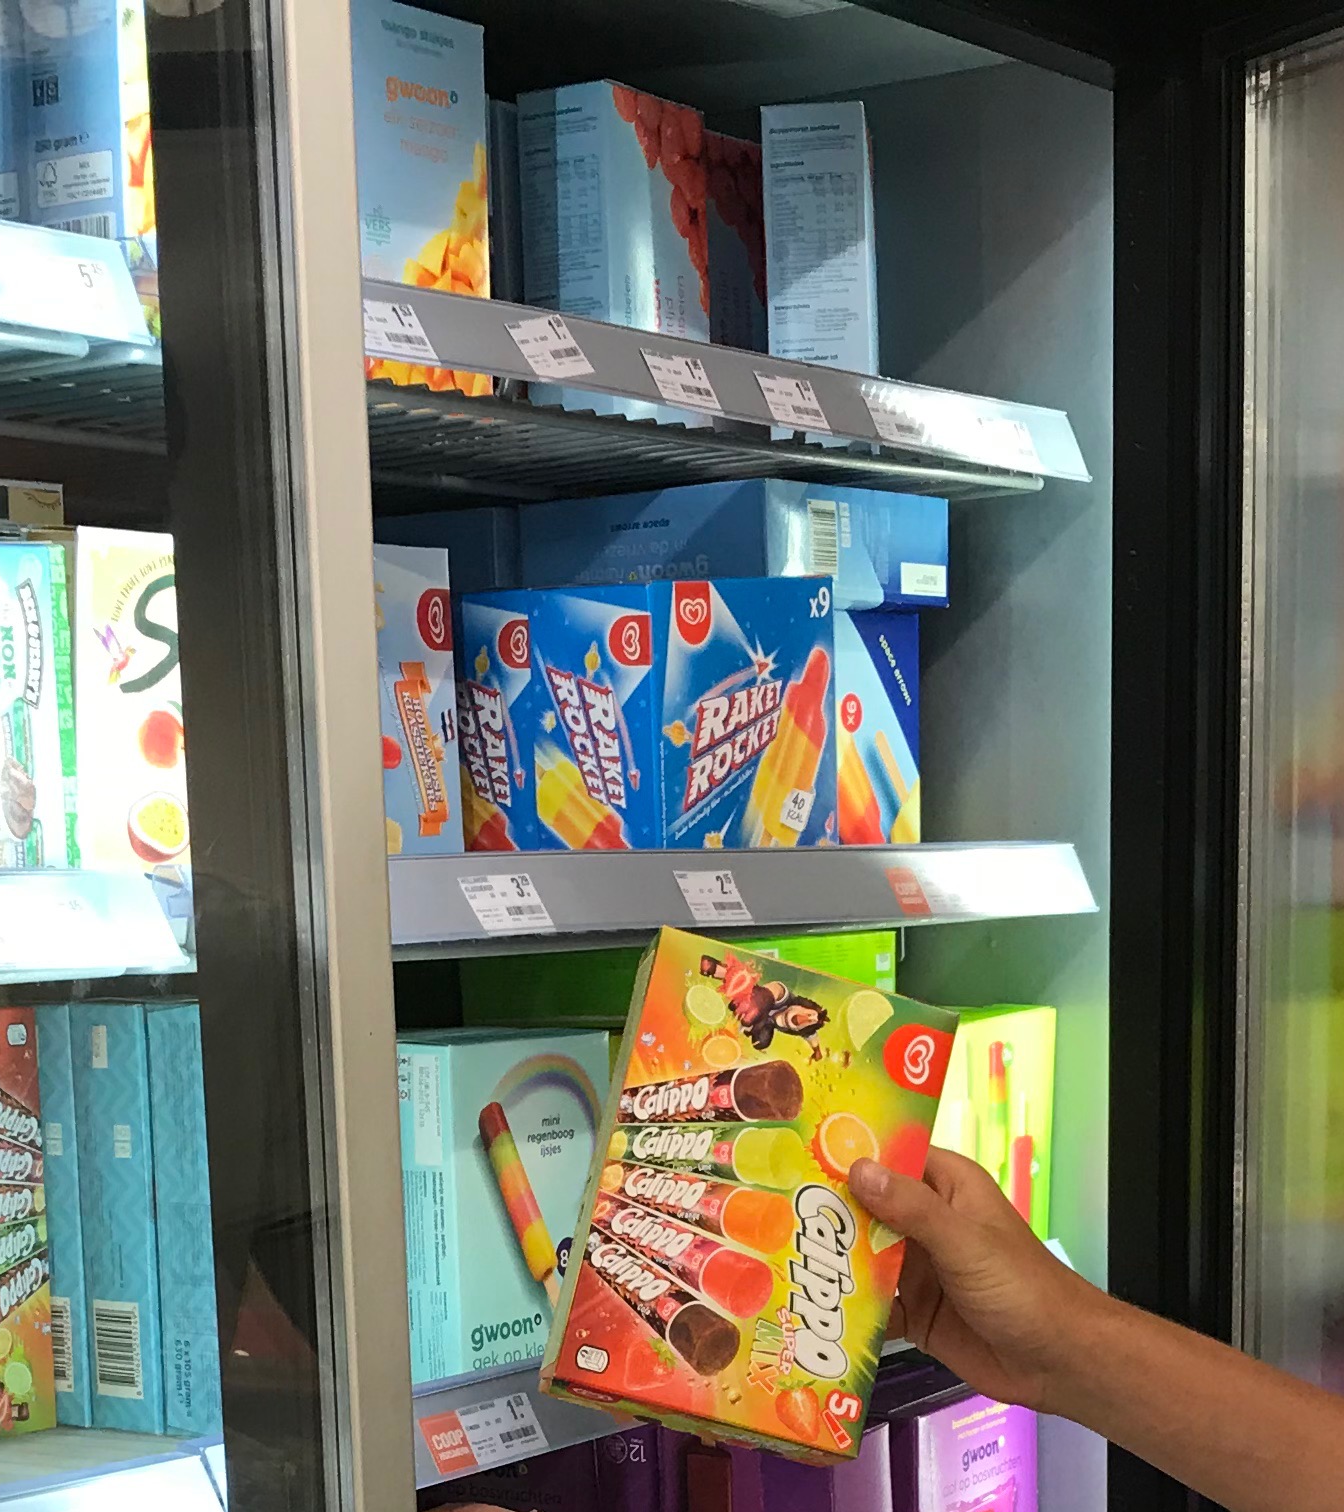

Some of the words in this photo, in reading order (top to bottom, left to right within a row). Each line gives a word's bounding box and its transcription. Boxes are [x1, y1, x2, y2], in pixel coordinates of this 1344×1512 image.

[386, 76, 450, 108] gwoon
[365, 217, 391, 233] VERS
[809, 587, 830, 618] x9
[879, 634, 897, 668] space
[894, 668, 912, 706] arrows
[695, 680, 783, 752] RAKET
[403, 691, 437, 811] KLASSIEKERS
[413, 698, 444, 802] HOLLANDSE
[472, 686, 511, 808] RAKET
[547, 667, 608, 807] ROCKET
[579, 679, 626, 809] RAKET
[687, 709, 783, 804] ROCKET
[786, 809, 804, 824] KCAL
[791, 792, 806, 811] 40
[633, 1076, 709, 1120] Calippo
[527, 1128, 574, 1144] regenboog
[542, 1115, 561, 1128] mini
[540, 1144, 562, 1157] ijsjes
[633, 1127, 714, 1162] Calippo
[624, 1167, 706, 1208] Calippo
[611, 1207, 695, 1257] Calippo
[559, 1249, 570, 1267] 8
[591, 1243, 672, 1301] Calippo
[0, 1258, 43, 1316] Calippo
[790, 1184, 856, 1380] Calippo
[470, 1318, 535, 1352] gwoon
[776, 1307, 798, 1375] SUPER
[503, 1350, 523, 1365] op
[747, 1316, 788, 1396] MIX
[829, 1392, 859, 1419] 5
[430, 1430, 465, 1450] COOP
[961, 1440, 999, 1472] gwoon
